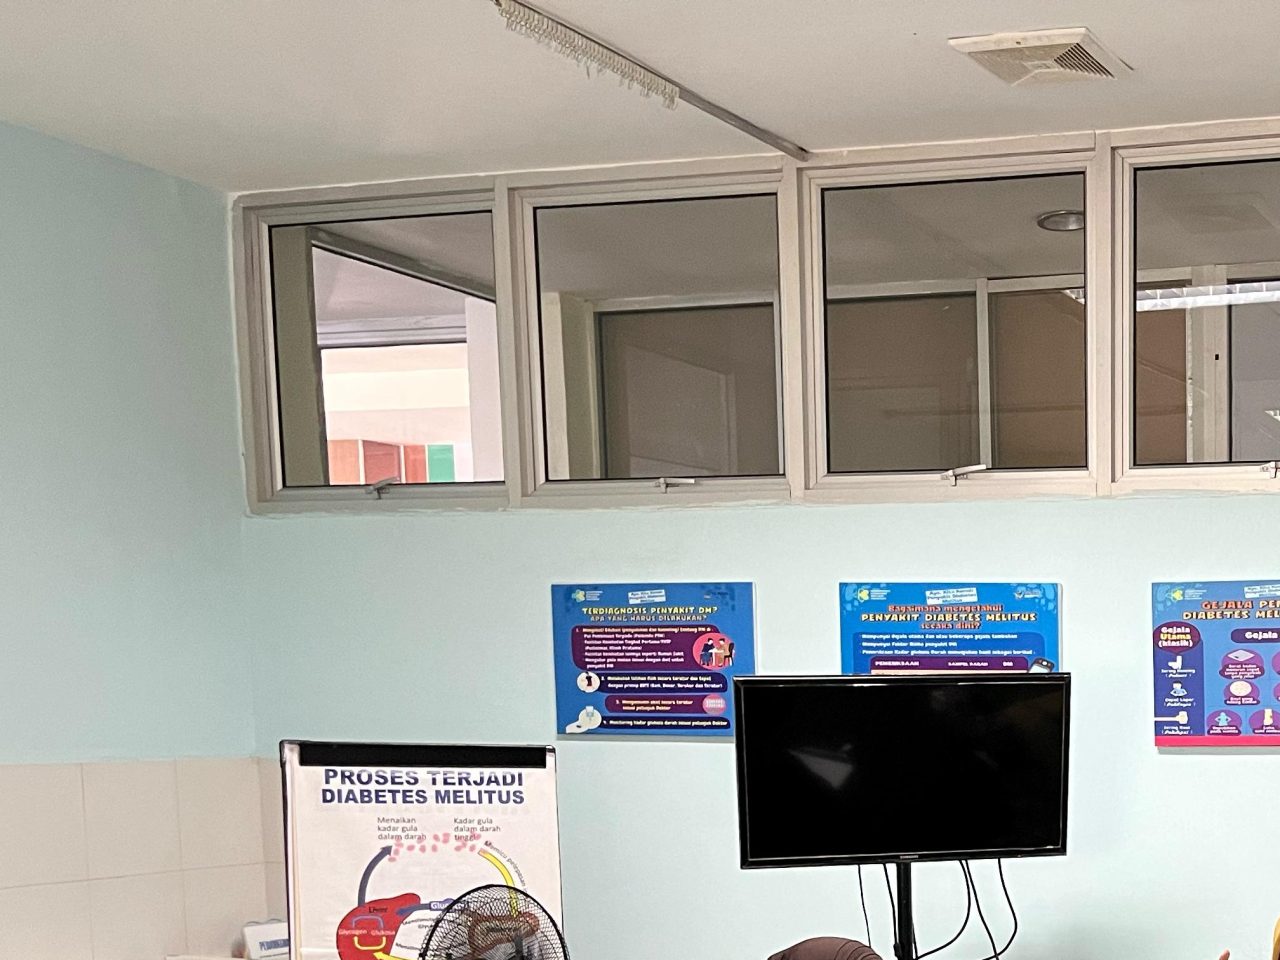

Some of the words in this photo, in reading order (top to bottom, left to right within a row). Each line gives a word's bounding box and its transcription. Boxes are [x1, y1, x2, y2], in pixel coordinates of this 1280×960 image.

[1202, 601, 1254, 609] GEJALA
[861, 614, 920, 622] PENYAKIT
[925, 614, 981, 622] DIABETES
[986, 613, 1036, 621] MELITUS
[1183, 610, 1250, 620] DIABETES
[1245, 631, 1278, 640] Gejala
[324, 769, 419, 785] PROSES
[427, 771, 523, 786] TERJADI
[321, 789, 427, 804] DIABETES
[435, 790, 524, 804] MELITUS
[402, 825, 418, 833] gula
